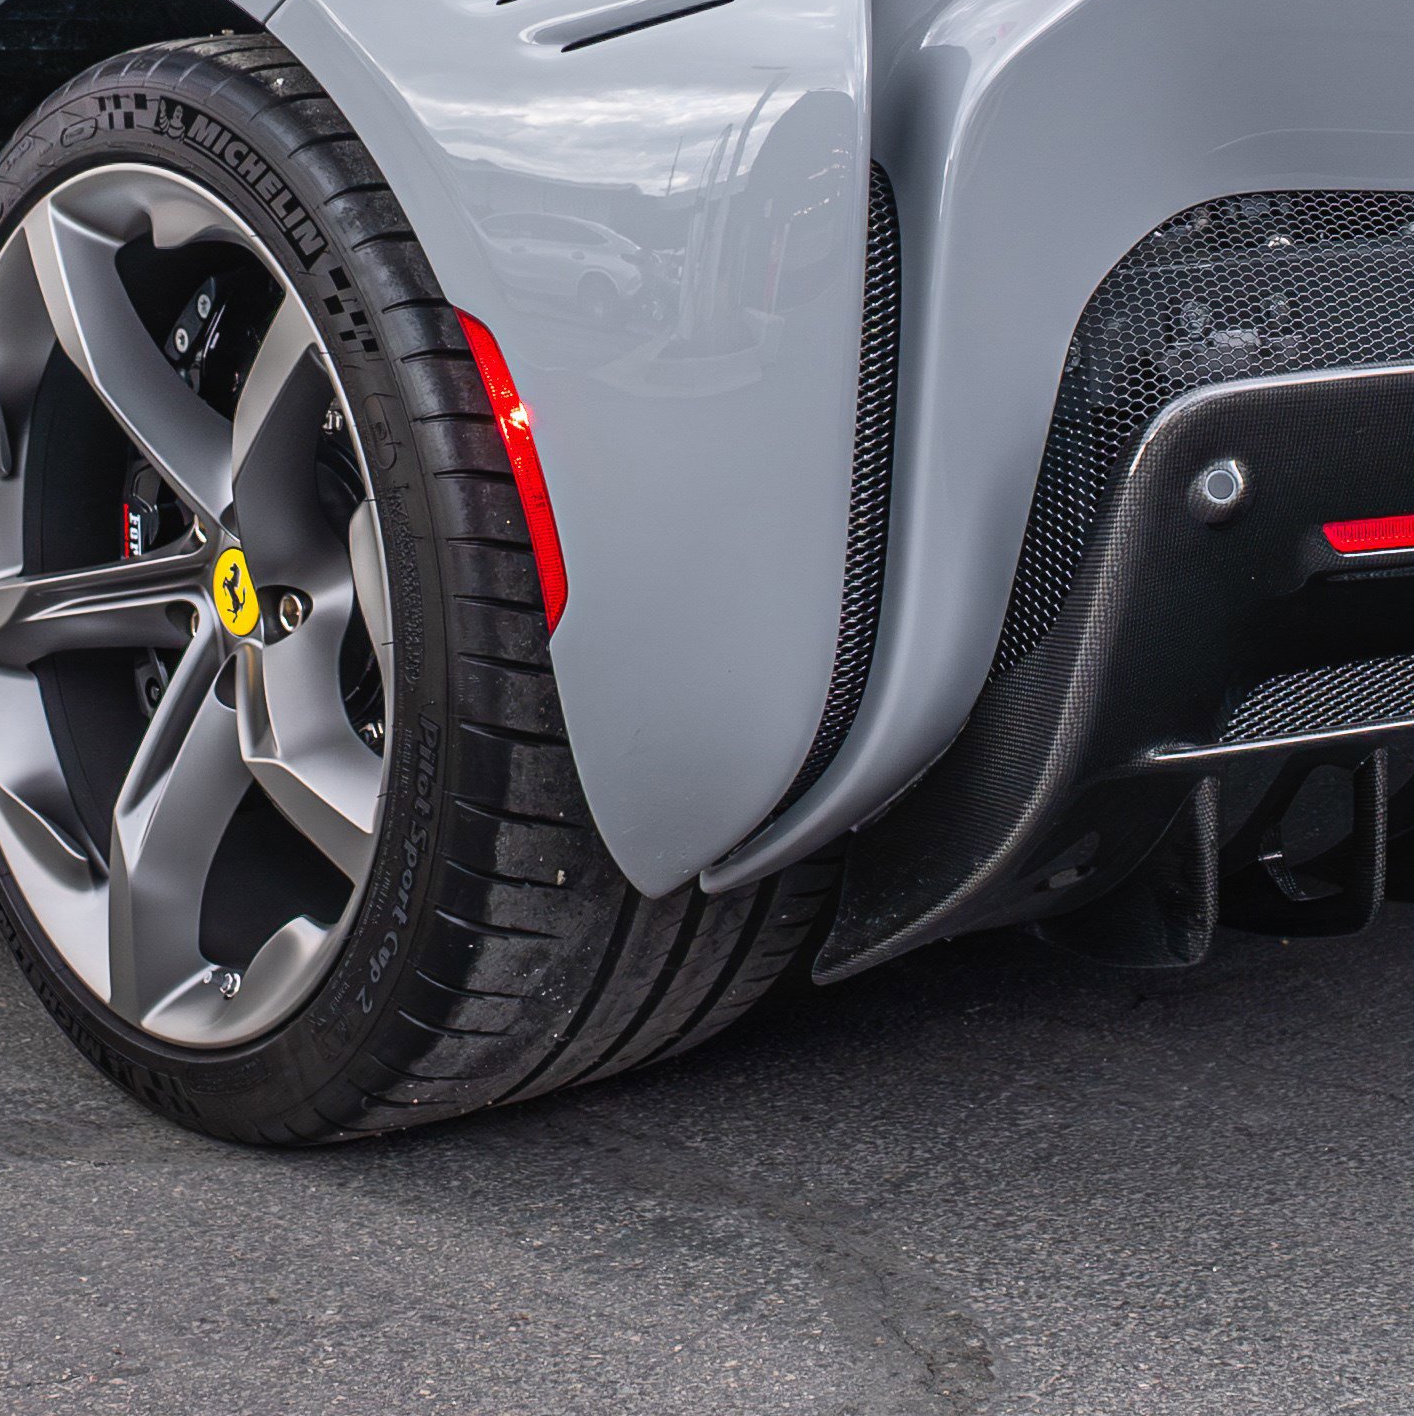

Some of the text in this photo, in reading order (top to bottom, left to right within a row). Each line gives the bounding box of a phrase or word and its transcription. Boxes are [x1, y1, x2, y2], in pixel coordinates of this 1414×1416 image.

[187, 114, 325, 256] MICHELIN
[415, 714, 441, 816] Pilot
[392, 819, 427, 927] Sport
[355, 985, 374, 1014] 2
[368, 931, 399, 983] Cup
